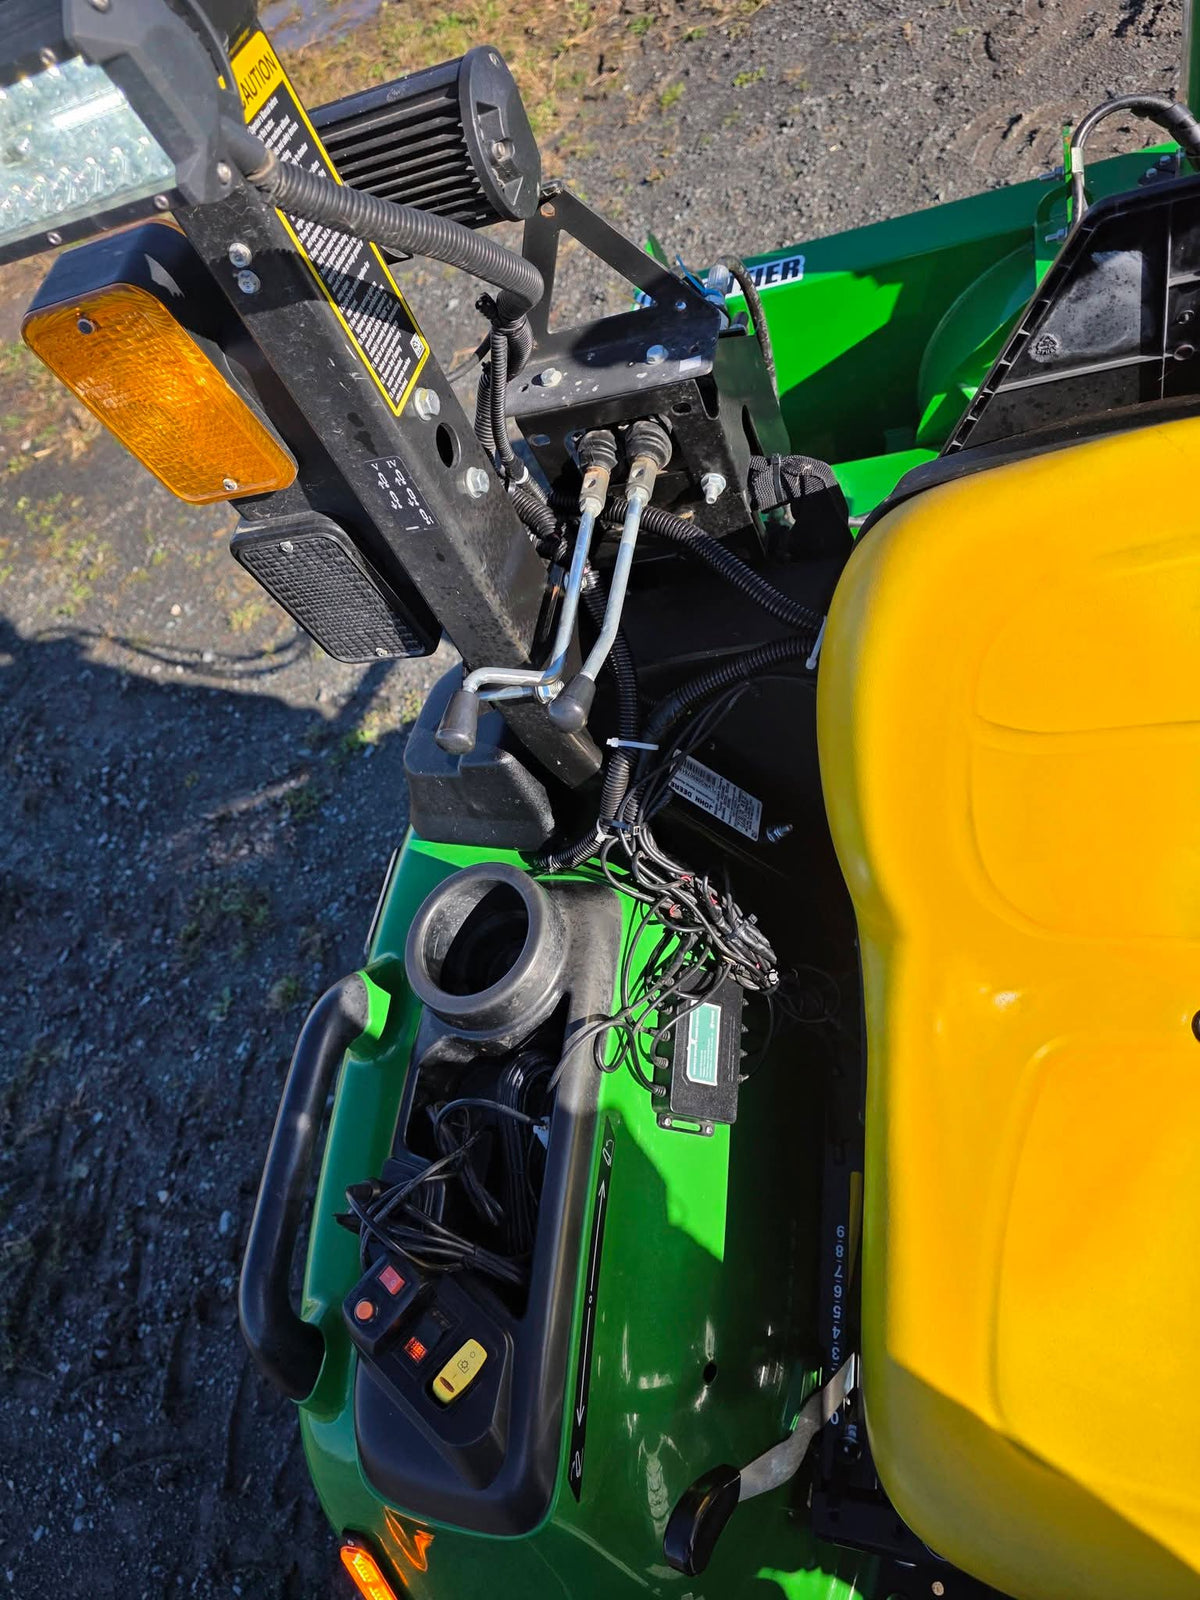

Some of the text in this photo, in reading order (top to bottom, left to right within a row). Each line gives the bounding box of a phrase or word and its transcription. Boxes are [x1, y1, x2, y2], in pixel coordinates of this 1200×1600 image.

[695, 795, 714, 811] JOHN
[837, 1225, 845, 1238] 9
[836, 1245, 844, 1257] 8
[834, 1265, 843, 1278] 7
[834, 1286, 842, 1298] 6
[833, 1305, 841, 1318] 5
[832, 1326, 841, 1339] 4
[831, 1347, 840, 1360] 3
